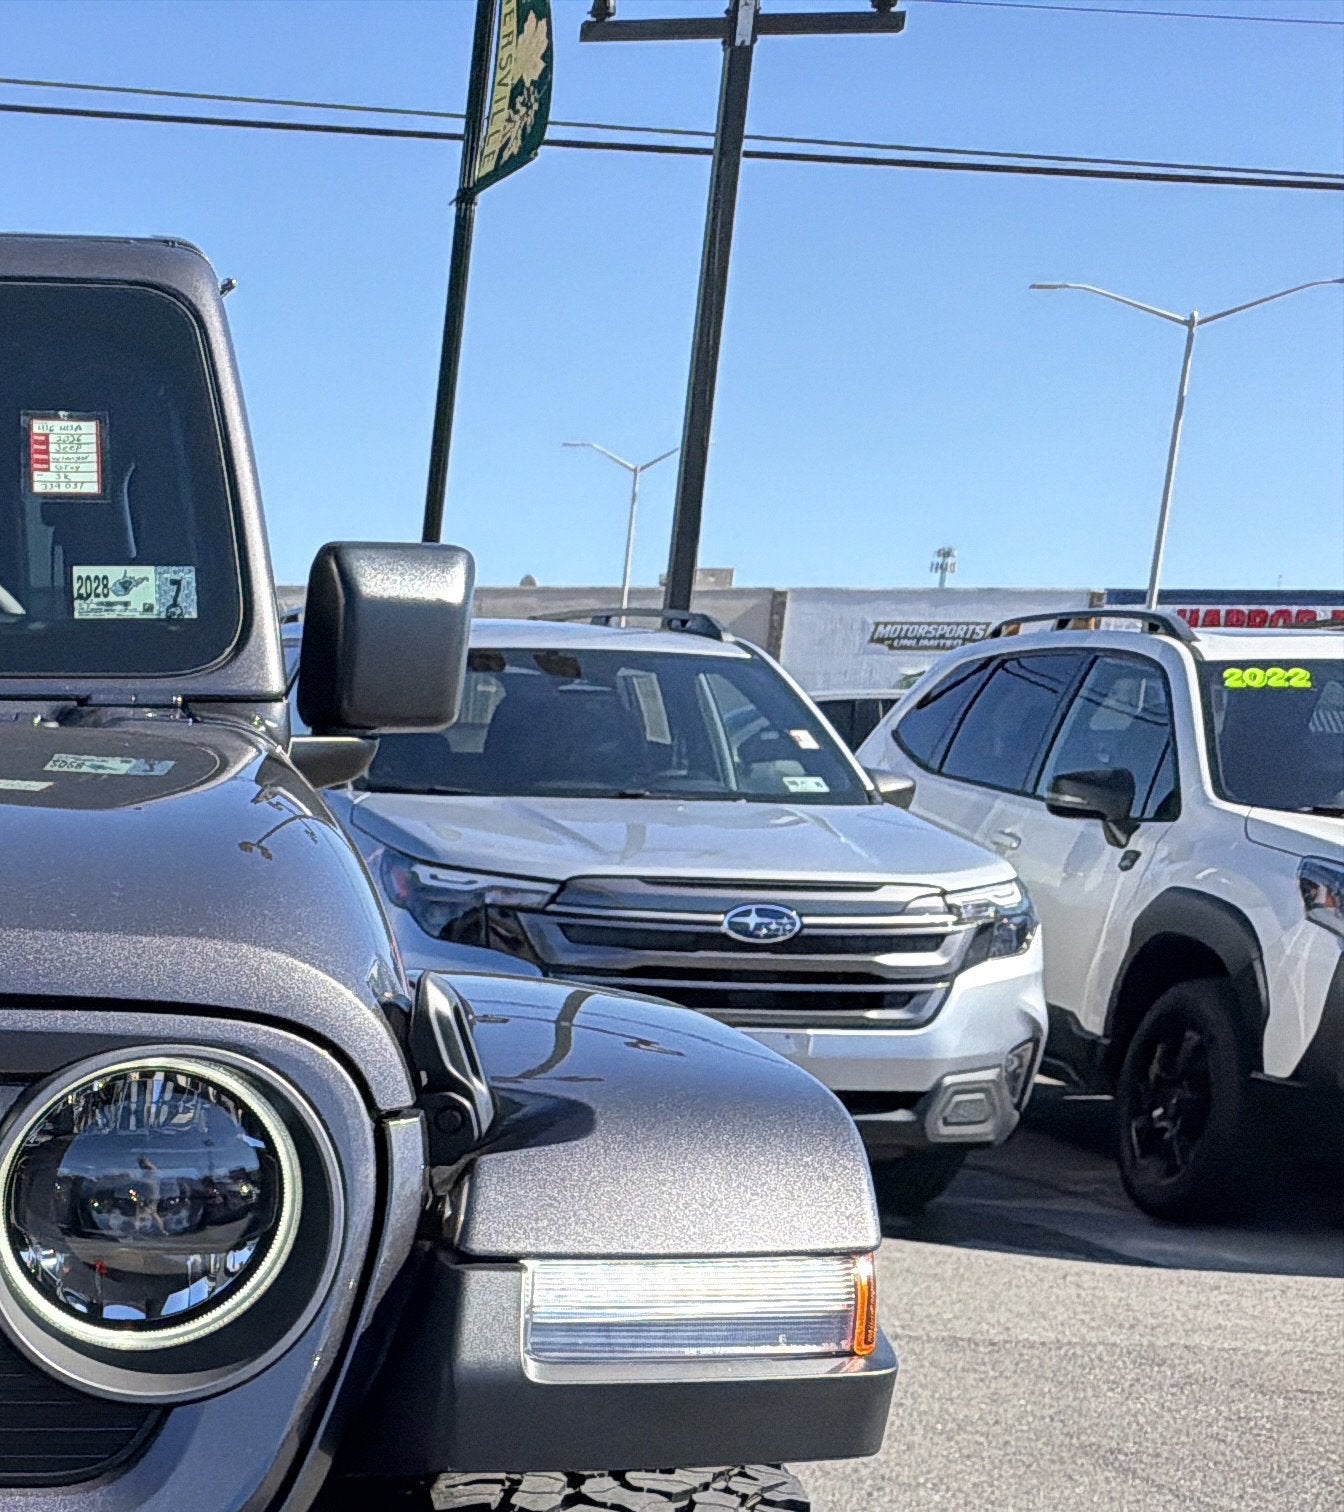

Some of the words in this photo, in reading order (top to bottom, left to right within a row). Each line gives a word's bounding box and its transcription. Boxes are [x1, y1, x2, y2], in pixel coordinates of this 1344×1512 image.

[76, 575, 109, 598] 2028
[874, 624, 986, 639] MOTORSPORTS
[1222, 667, 1312, 689] 2022
